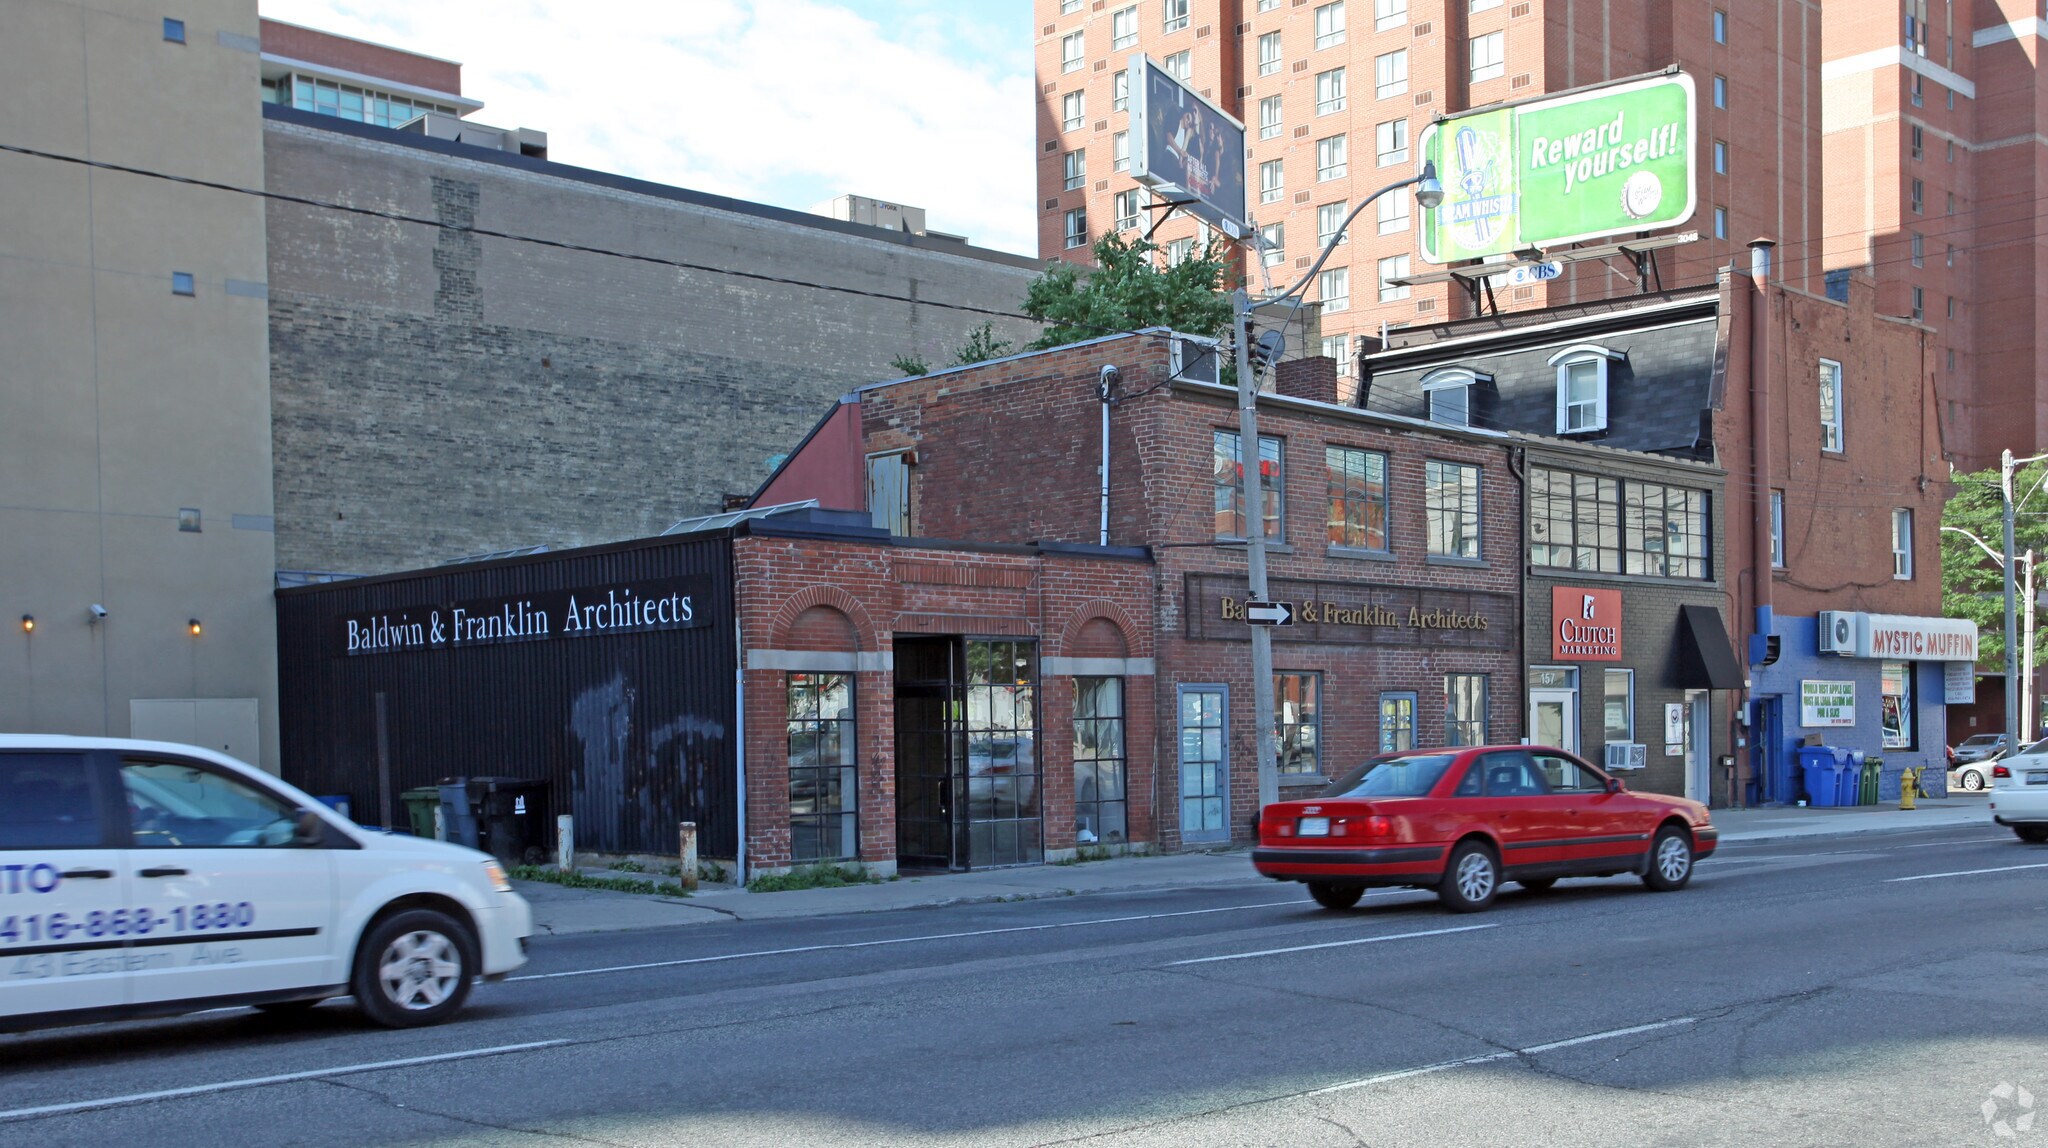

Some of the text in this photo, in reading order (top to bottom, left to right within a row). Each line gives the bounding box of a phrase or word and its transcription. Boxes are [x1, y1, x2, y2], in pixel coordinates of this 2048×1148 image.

[1530, 110, 1624, 169] Reward
[1564, 121, 1678, 195] yourself!
[1528, 264, 1556, 280] CBS
[347, 588, 693, 650] Baldwin & Franklin Architects
[1302, 600, 1319, 623] &
[1322, 601, 1401, 629] Franklin,
[1407, 606, 1488, 631] Architects
[1560, 618, 1616, 644] CLUTCH
[1873, 629, 1973, 657] MYSTIC MUFFIN
[1561, 645, 1617, 655] MARKETING
[1540, 672, 1555, 685] 157
[0, 901, 255, 943] 416-868-1880
[62, 950, 174, 977] Eastern
